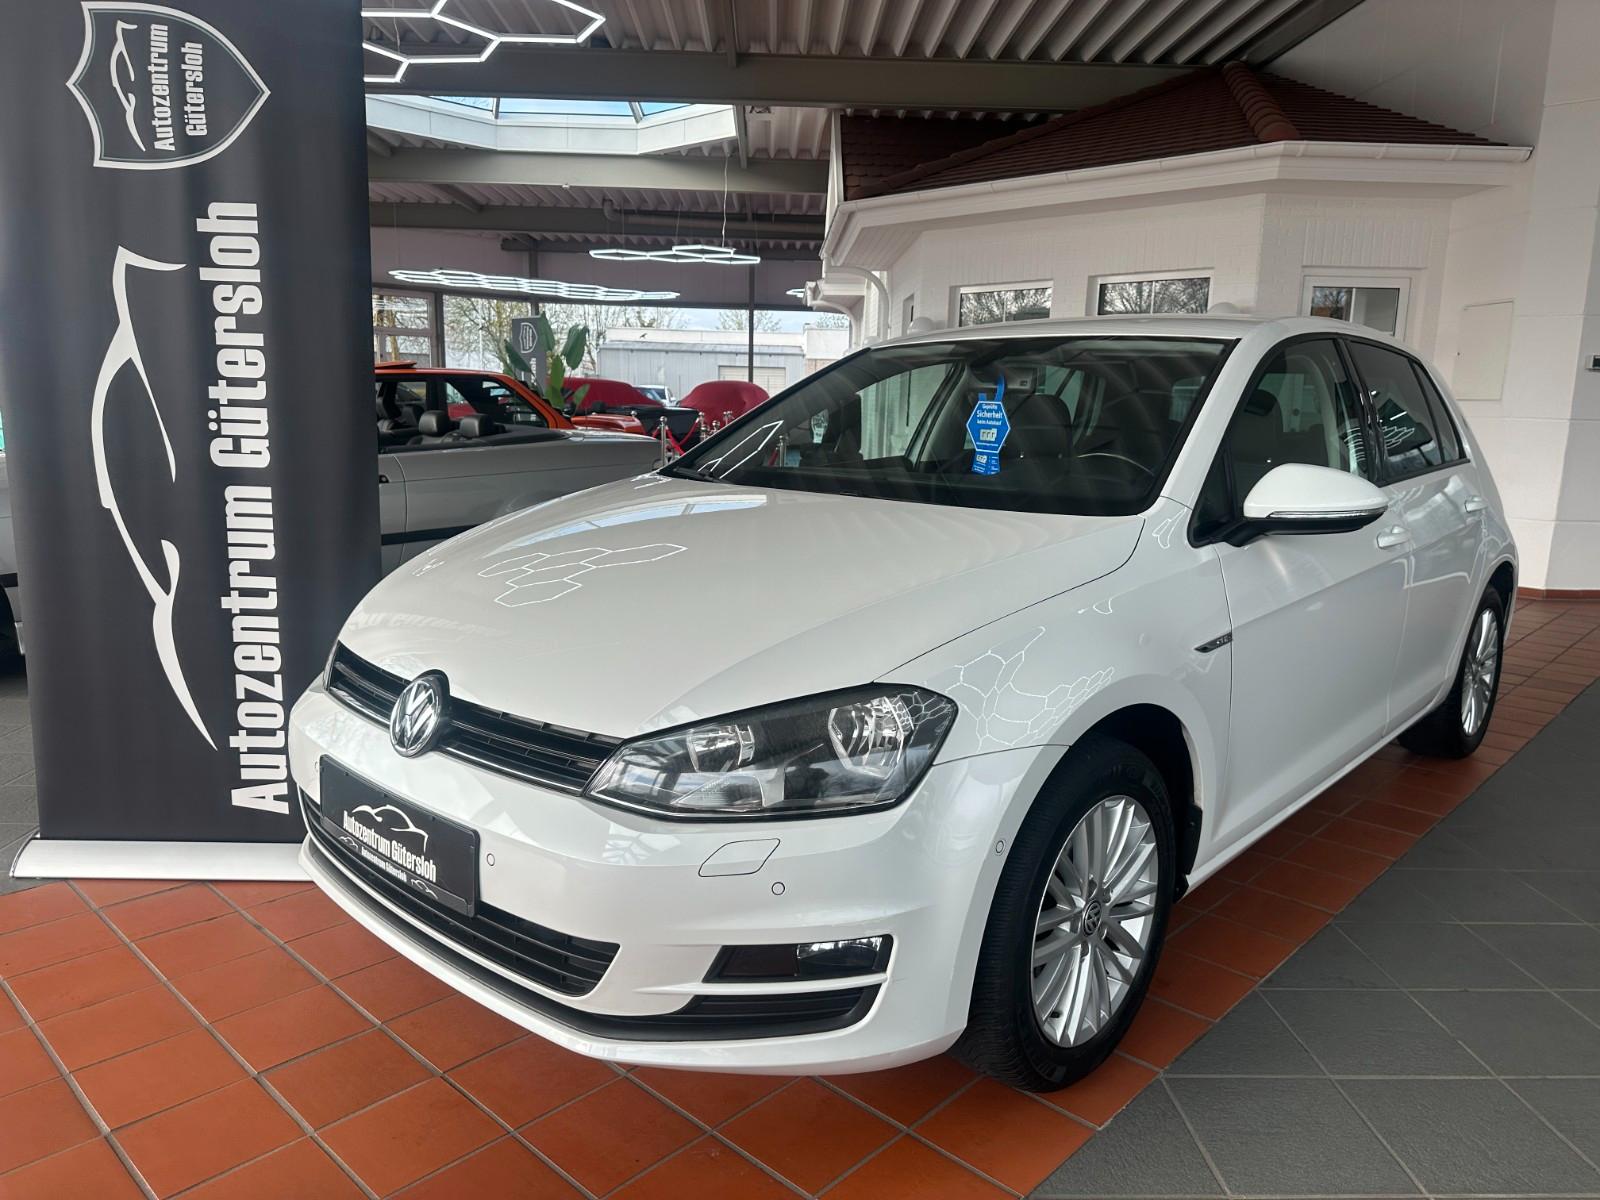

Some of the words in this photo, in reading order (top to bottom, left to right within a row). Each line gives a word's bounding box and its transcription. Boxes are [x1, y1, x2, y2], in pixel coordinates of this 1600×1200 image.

[148, 24, 175, 151] Autozentrum
[181, 42, 208, 136] Gütersloh
[196, 202, 271, 468] Gütersloh
[221, 485, 289, 815] Autozentrum
[343, 810, 390, 857] Autozentrum
[391, 840, 437, 882] Gütersloh
